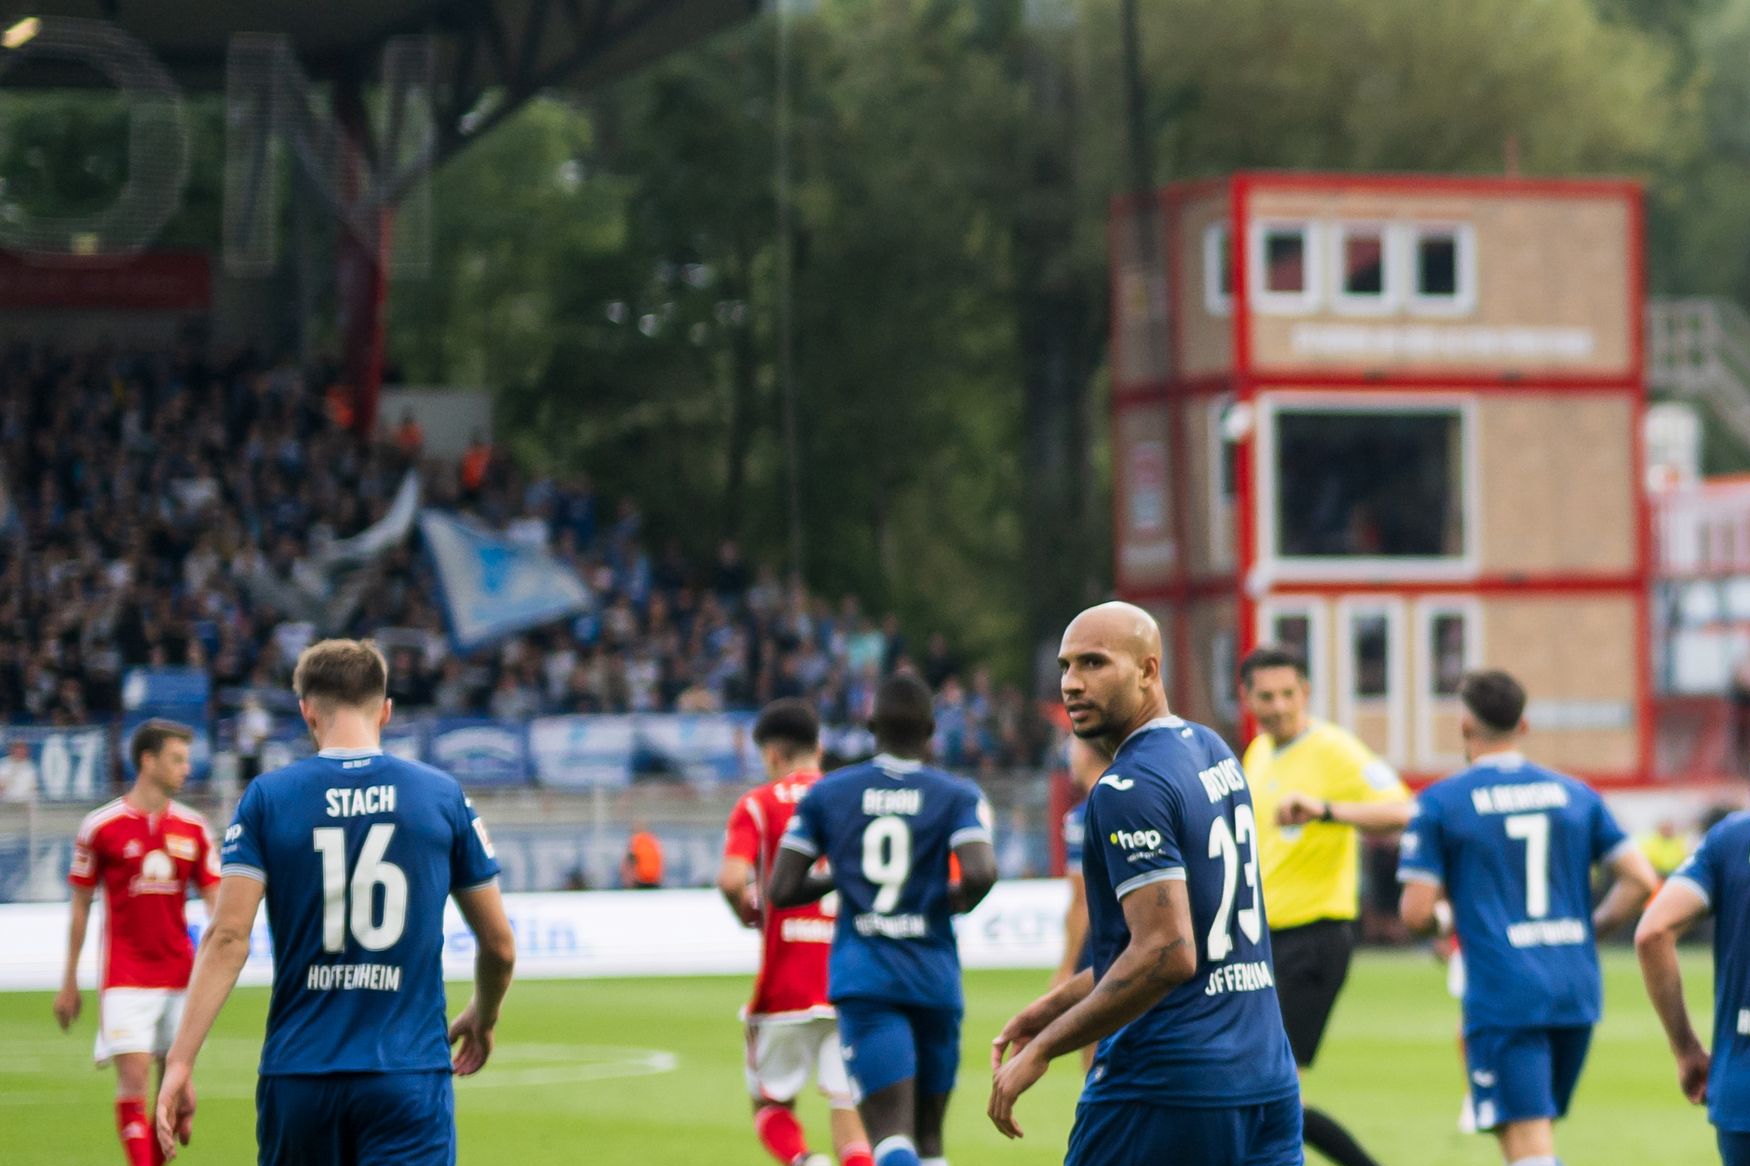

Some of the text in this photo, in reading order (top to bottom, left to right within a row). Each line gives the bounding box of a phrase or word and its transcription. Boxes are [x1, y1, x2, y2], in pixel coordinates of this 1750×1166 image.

[325, 785, 396, 818] STACH
[1117, 829, 1161, 850] hep
[313, 823, 408, 953] 16
[861, 815, 910, 914] 9
[1207, 804, 1263, 962] 23
